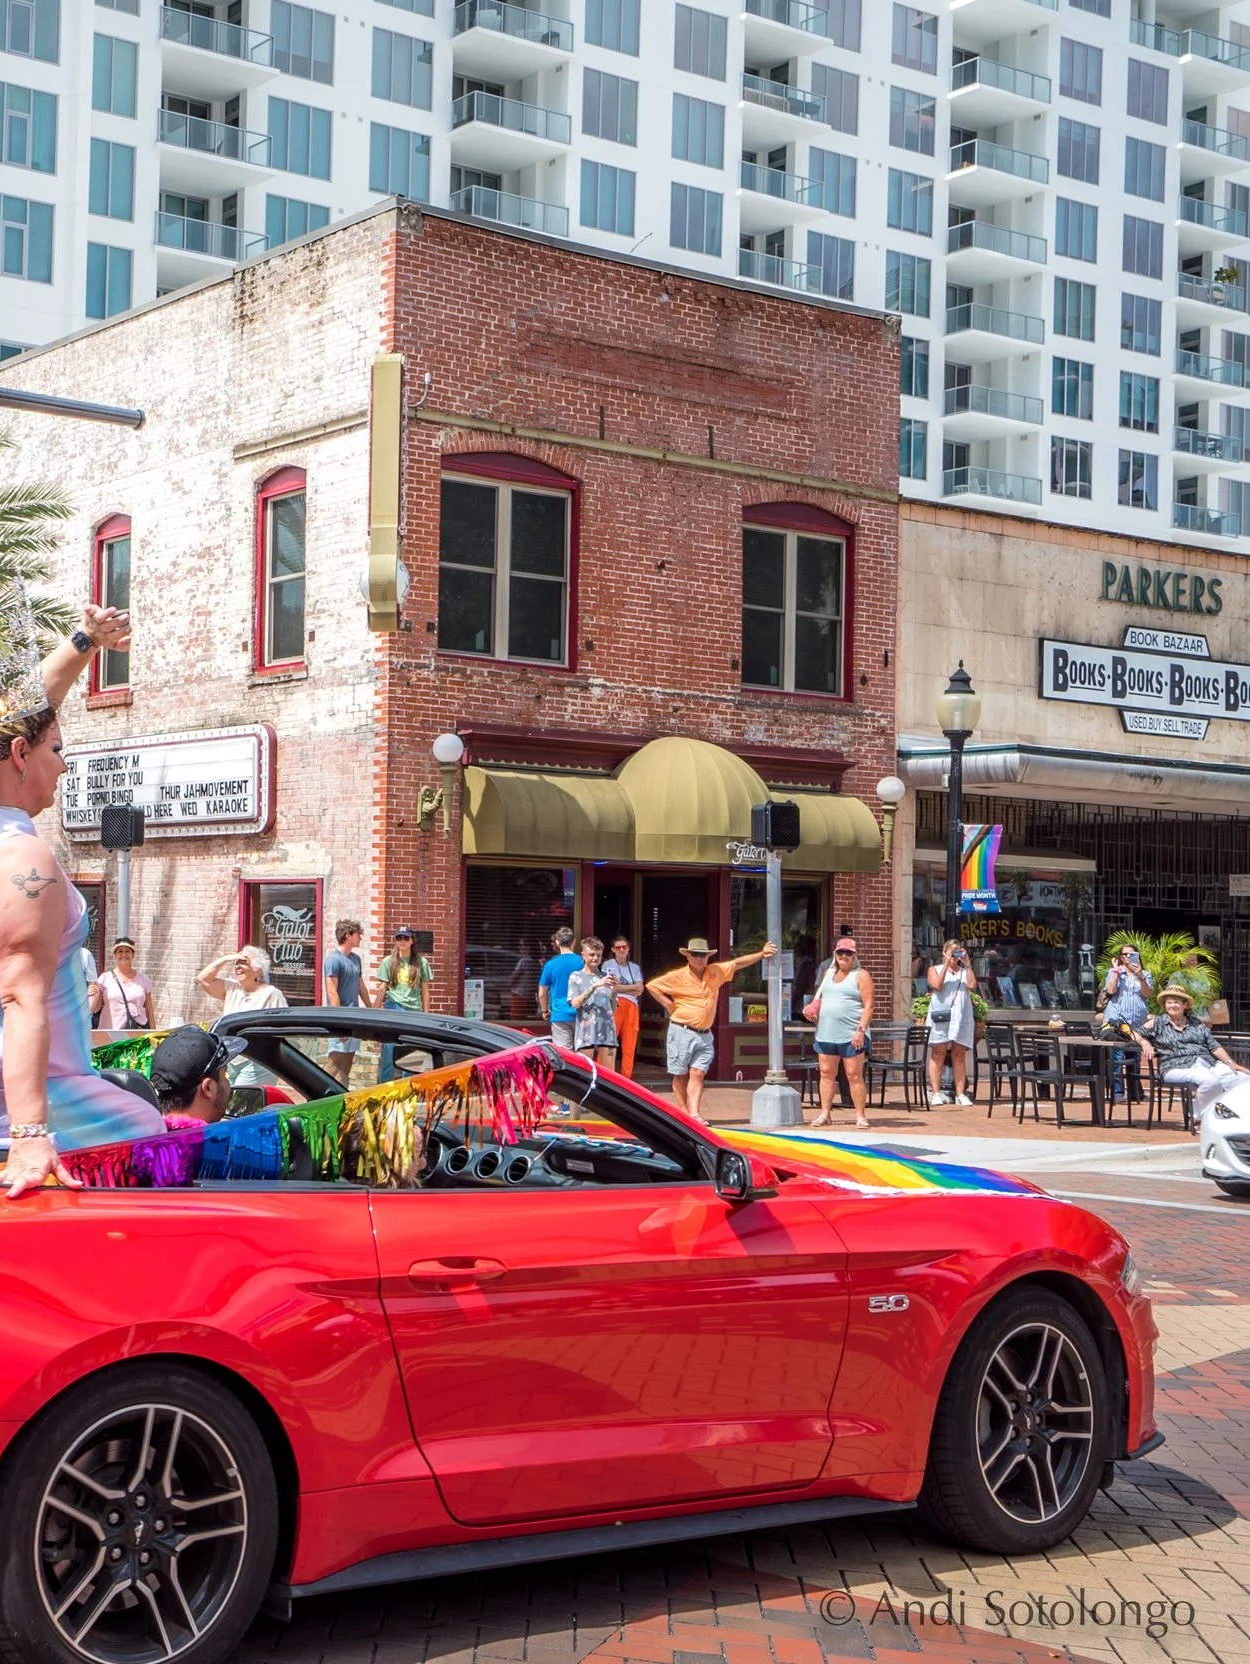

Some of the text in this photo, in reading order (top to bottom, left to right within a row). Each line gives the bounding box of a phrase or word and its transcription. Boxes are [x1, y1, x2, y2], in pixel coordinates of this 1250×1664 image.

[1102, 560, 1223, 615] PARKERS
[1130, 631, 1203, 653] BOOK BAZAAR
[1225, 670, 1250, 712] BO
[88, 755, 129, 773] FREQUENCY
[132, 754, 140, 768] M
[66, 771, 144, 791] SAT BULLY FOR YOU
[66, 793, 79, 807] TUE
[111, 789, 134, 804] BINGO
[160, 785, 181, 800] THUR
[184, 780, 249, 799] JAHMOVEMENT
[153, 803, 173, 818] HERE
[180, 801, 198, 816] WED
[206, 798, 248, 815] KARAOKE
[275, 919, 314, 939] Gator
[960, 919, 1064, 948] RKER'S BOOKS
[269, 937, 304, 963] Club
[868, 1294, 910, 1313] 5.0
